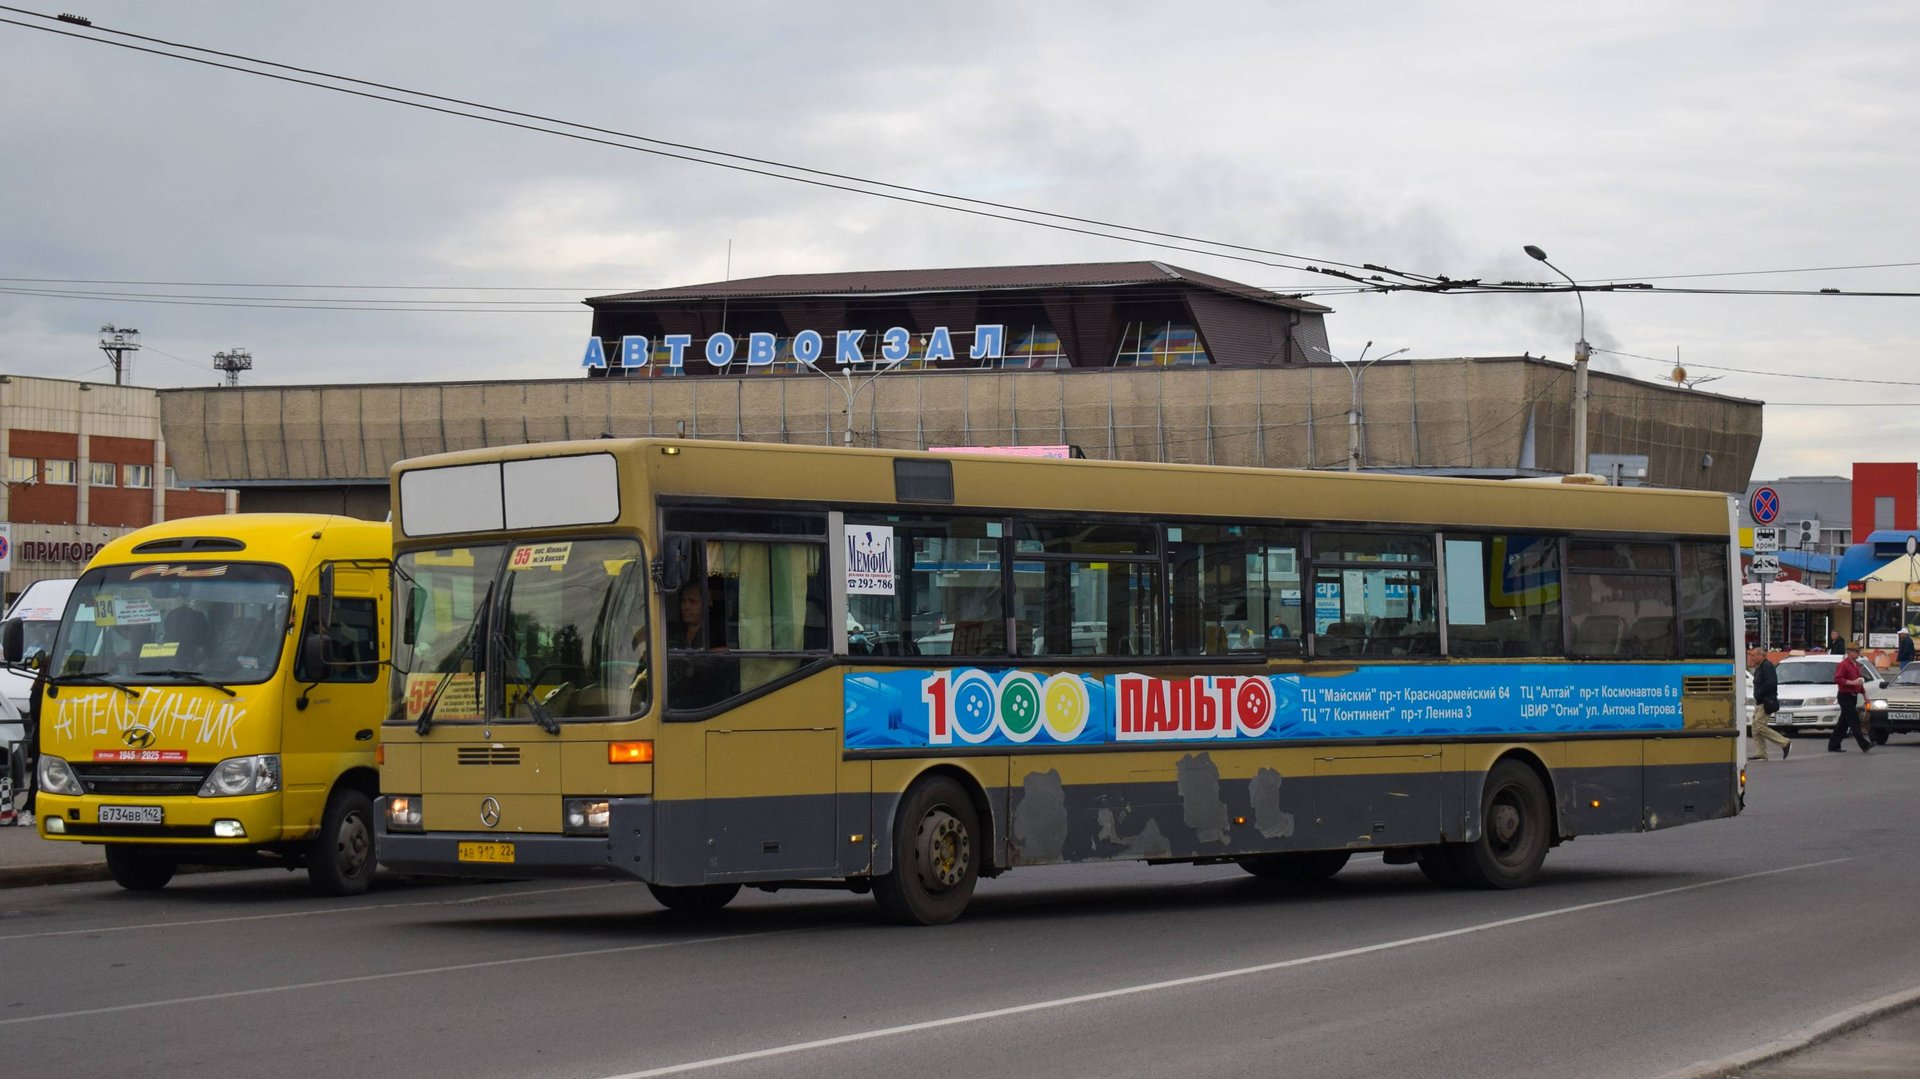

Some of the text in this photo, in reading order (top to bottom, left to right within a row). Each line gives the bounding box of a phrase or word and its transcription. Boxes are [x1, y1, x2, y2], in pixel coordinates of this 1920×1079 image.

[581, 324, 1003, 369] АВТОВОКЗАЛ
[514, 547, 532, 565] 55
[857, 578, 893, 589] 292-786
[95, 600, 114, 618] 134
[1301, 686, 1510, 704] ТЦ "Майский" пр-т Красноармейский 64
[1520, 686, 1533, 700] ТЦ
[1536, 685, 1575, 698] "Алтай"
[1579, 687, 1600, 701] пр-т
[1602, 685, 1662, 698] Космонавтов
[1664, 684, 1670, 697] 6
[1119, 675, 1274, 736] ПАЛЬТО
[1301, 705, 1472, 724] ТЦ "7 Континент" пр-т Ленина 3
[1520, 704, 1548, 719] ЦВИР
[1551, 704, 1584, 717] "Огни"
[1586, 705, 1600, 719] ул.
[1602, 703, 1636, 716] Антона
[1638, 703, 1676, 717] Петрова
[119, 750, 136, 761] 1945
[141, 750, 160, 761] 2025
[501, 845, 511, 856] 22
